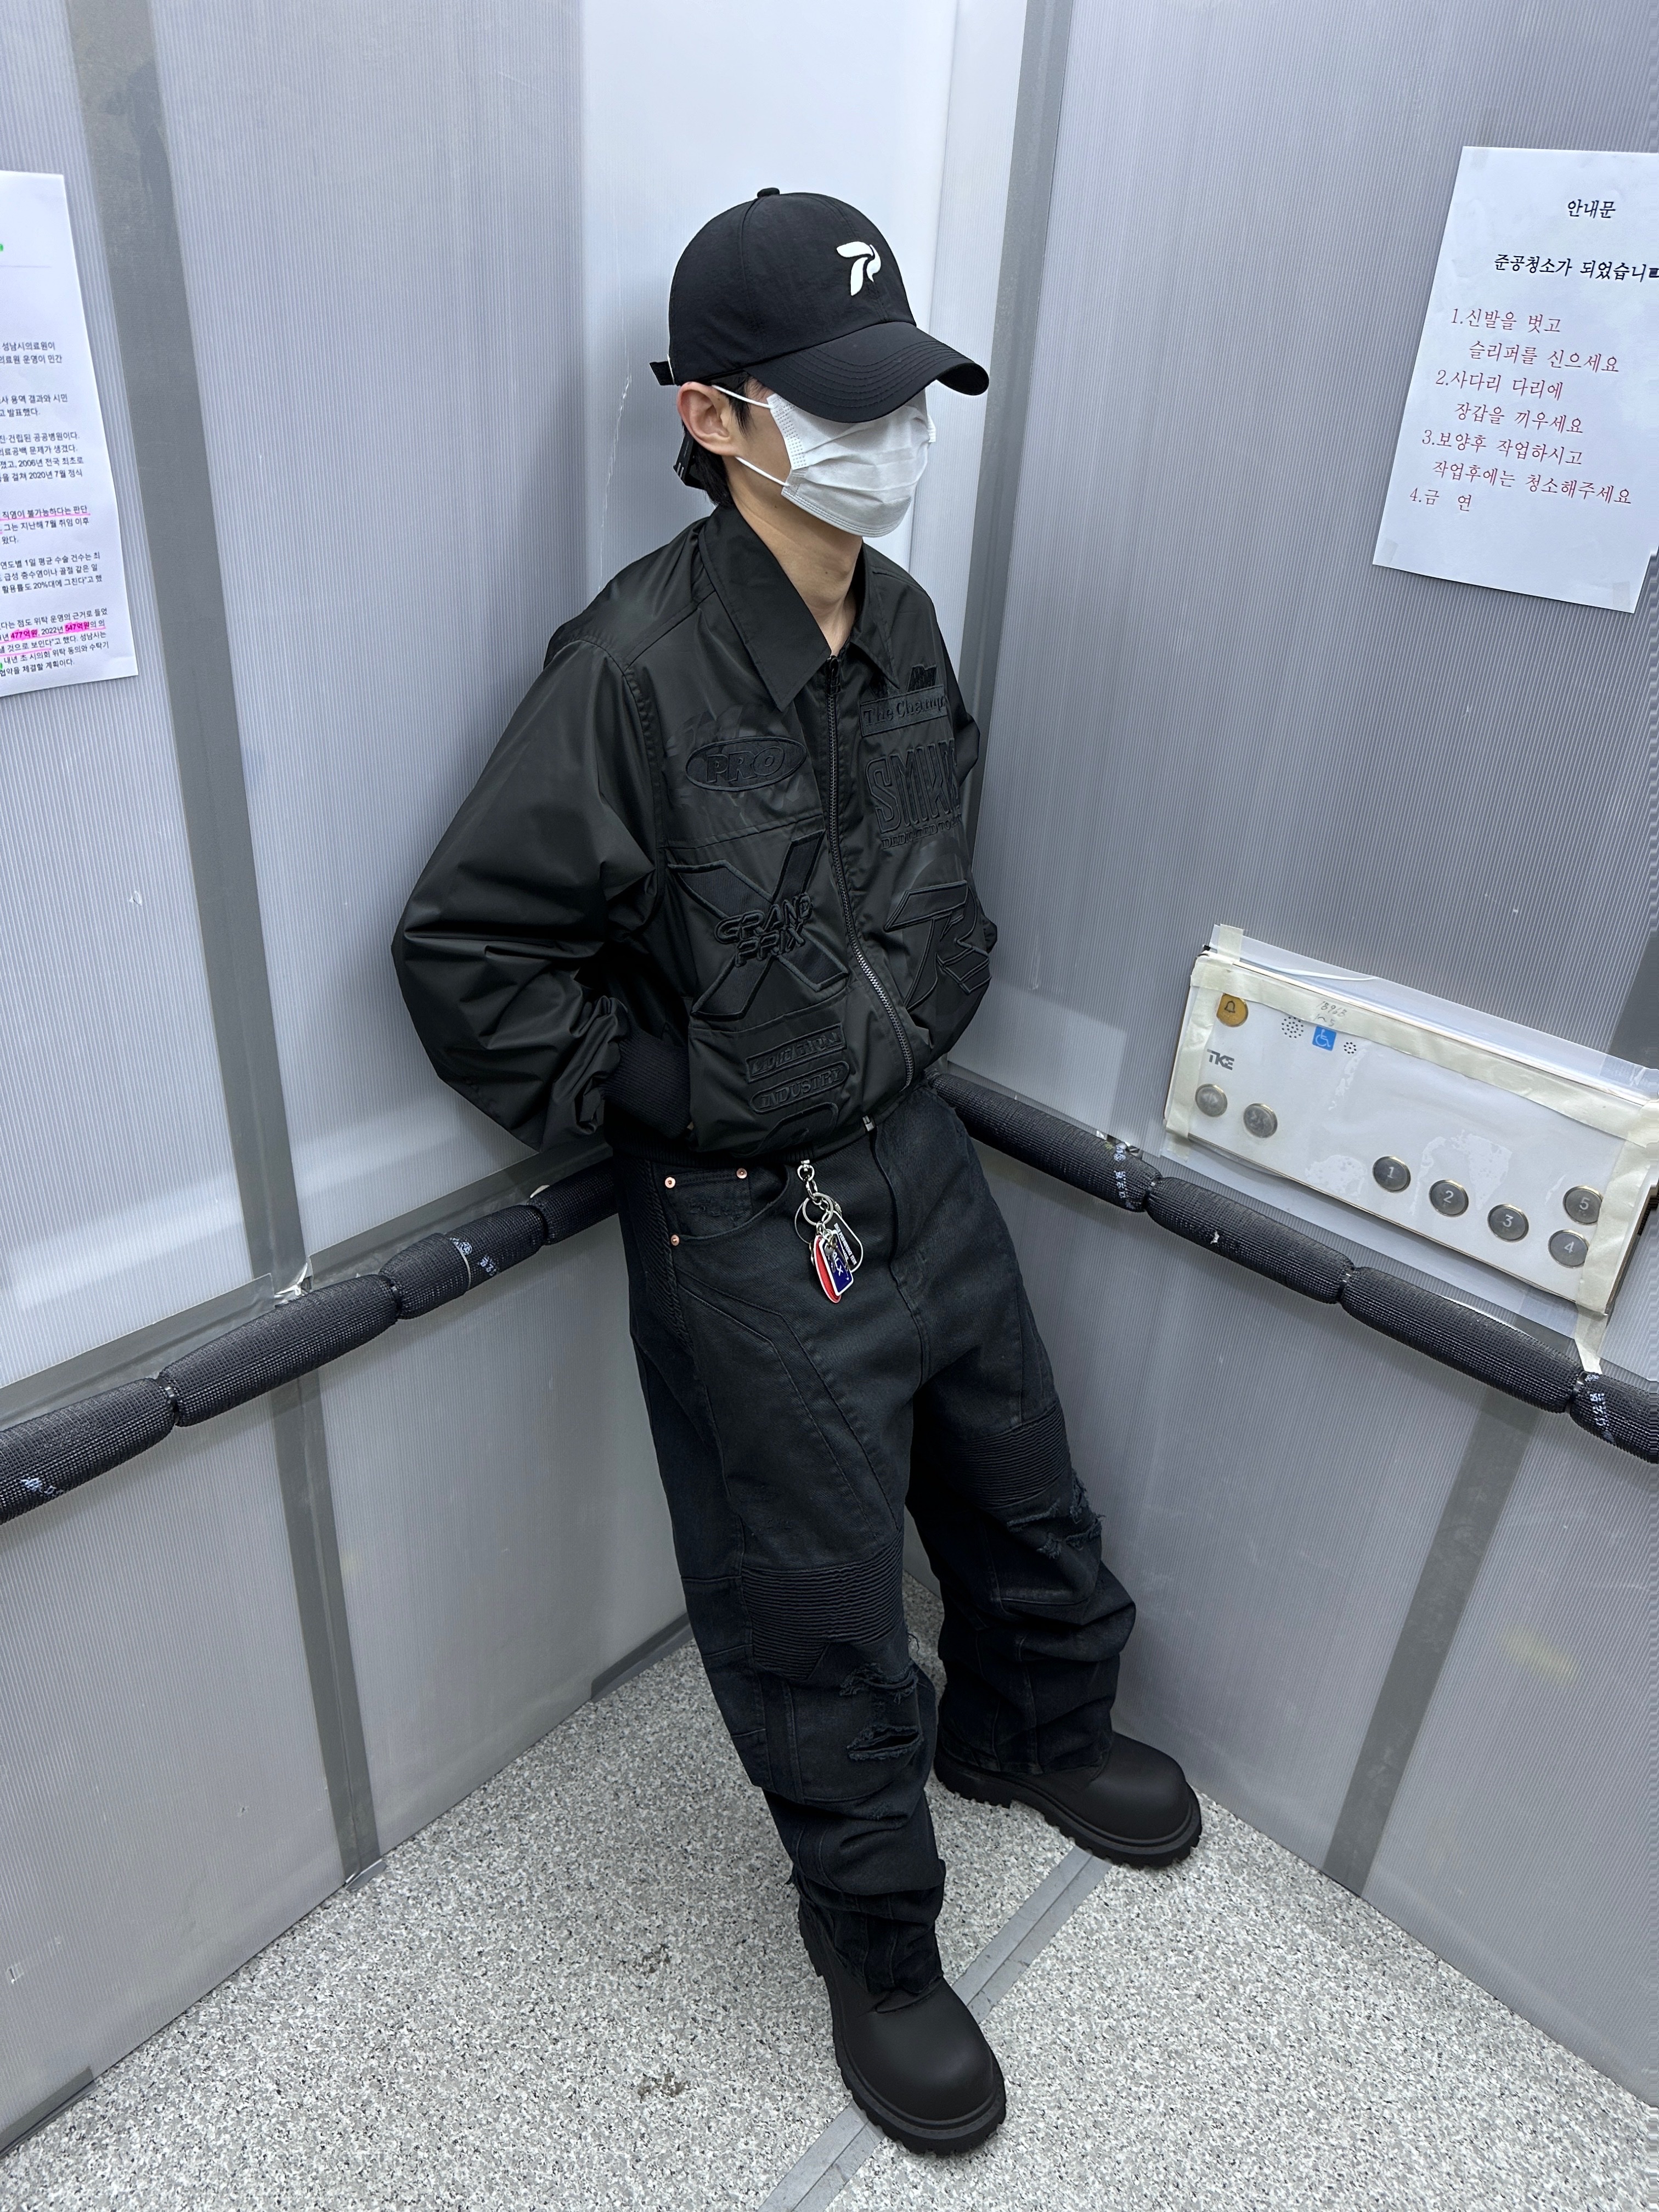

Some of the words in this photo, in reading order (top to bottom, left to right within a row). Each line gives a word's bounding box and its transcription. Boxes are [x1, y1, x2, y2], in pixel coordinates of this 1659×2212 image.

[1567, 199, 1616, 219] 안내문
[1494, 253, 1573, 277] 준공청소가
[1451, 308, 1517, 331] 1.신발을
[1527, 313, 1561, 334] 벗고
[2, 341, 55, 352] 성남시의료원이
[23, 355, 46, 364] 운영이
[47, 354, 63, 363] 민간
[1469, 340, 1538, 365] 슬리퍼를
[1547, 349, 1620, 373] 신으세요
[1436, 369, 1501, 394] 2.사다리
[1513, 377, 1564, 402] 다리에
[0, 396, 8, 404] 사
[53, 393, 67, 403] 시민
[1454, 402, 1505, 425] 장갑을
[1514, 409, 1583, 435] 끼우세요
[29, 445, 52, 455] 문제가
[1421, 429, 1487, 454] 3.보양후
[1496, 438, 1583, 466] 작업하시고
[45, 458, 60, 467] 전국
[62, 456, 84, 465] 최초로
[29, 470, 53, 479] 2020년
[54, 470, 66, 478] 7월
[68, 469, 83, 478] 정식
[1432, 460, 1516, 488] 작업후에는
[1525, 474, 1632, 505] 청소해주세요
[2, 510, 25, 520] 직영이
[27, 506, 71, 518] 불가능하다는
[73, 505, 88, 514] 판단
[1457, 494, 1472, 512] 연
[4, 523, 19, 532] 그는
[20, 521, 43, 531] 지난해
[45, 520, 57, 528] 7월
[59, 518, 73, 527] 취임
[75, 517, 89, 526] 이후
[0, 560, 22, 570] 연도별
[25, 558, 36, 567] 1일
[38, 557, 53, 566] 평균
[55, 555, 69, 564] 수술
[71, 553, 92, 563] 건수는
[93, 551, 100, 560] 최
[4, 572, 19, 582] 급성
[91, 563, 98, 572] 일
[0, 622, 15, 630] 다는
[17, 618, 33, 628] 점도
[34, 616, 48, 625] 위탁
[50, 613, 71, 623] 운영의
[72, 610, 93, 620] 근거로
[41, 625, 63, 635] 2022년
[98, 619, 105, 627] 의
[7, 642, 30, 652] 것으로
[80, 631, 107, 641] 성남시는
[4, 656, 18, 664] 내년
[29, 651, 50, 661] 시의회
[52, 648, 65, 657] 위탁
[67, 645, 88, 655] 동의와
[89, 641, 109, 651] 수탁기
[864, 709, 894, 726] The
[706, 747, 785, 783] PRO
[714, 891, 813, 945] GRAND
[734, 925, 805, 967] PRIX
[1207, 1048, 1234, 1070] TKE
[1388, 1166, 1395, 1178] 1
[1443, 1190, 1454, 1203] 2
[1578, 1197, 1590, 1210] 5
[1502, 1215, 1514, 1227] 3
[1564, 1241, 1575, 1254] 4
